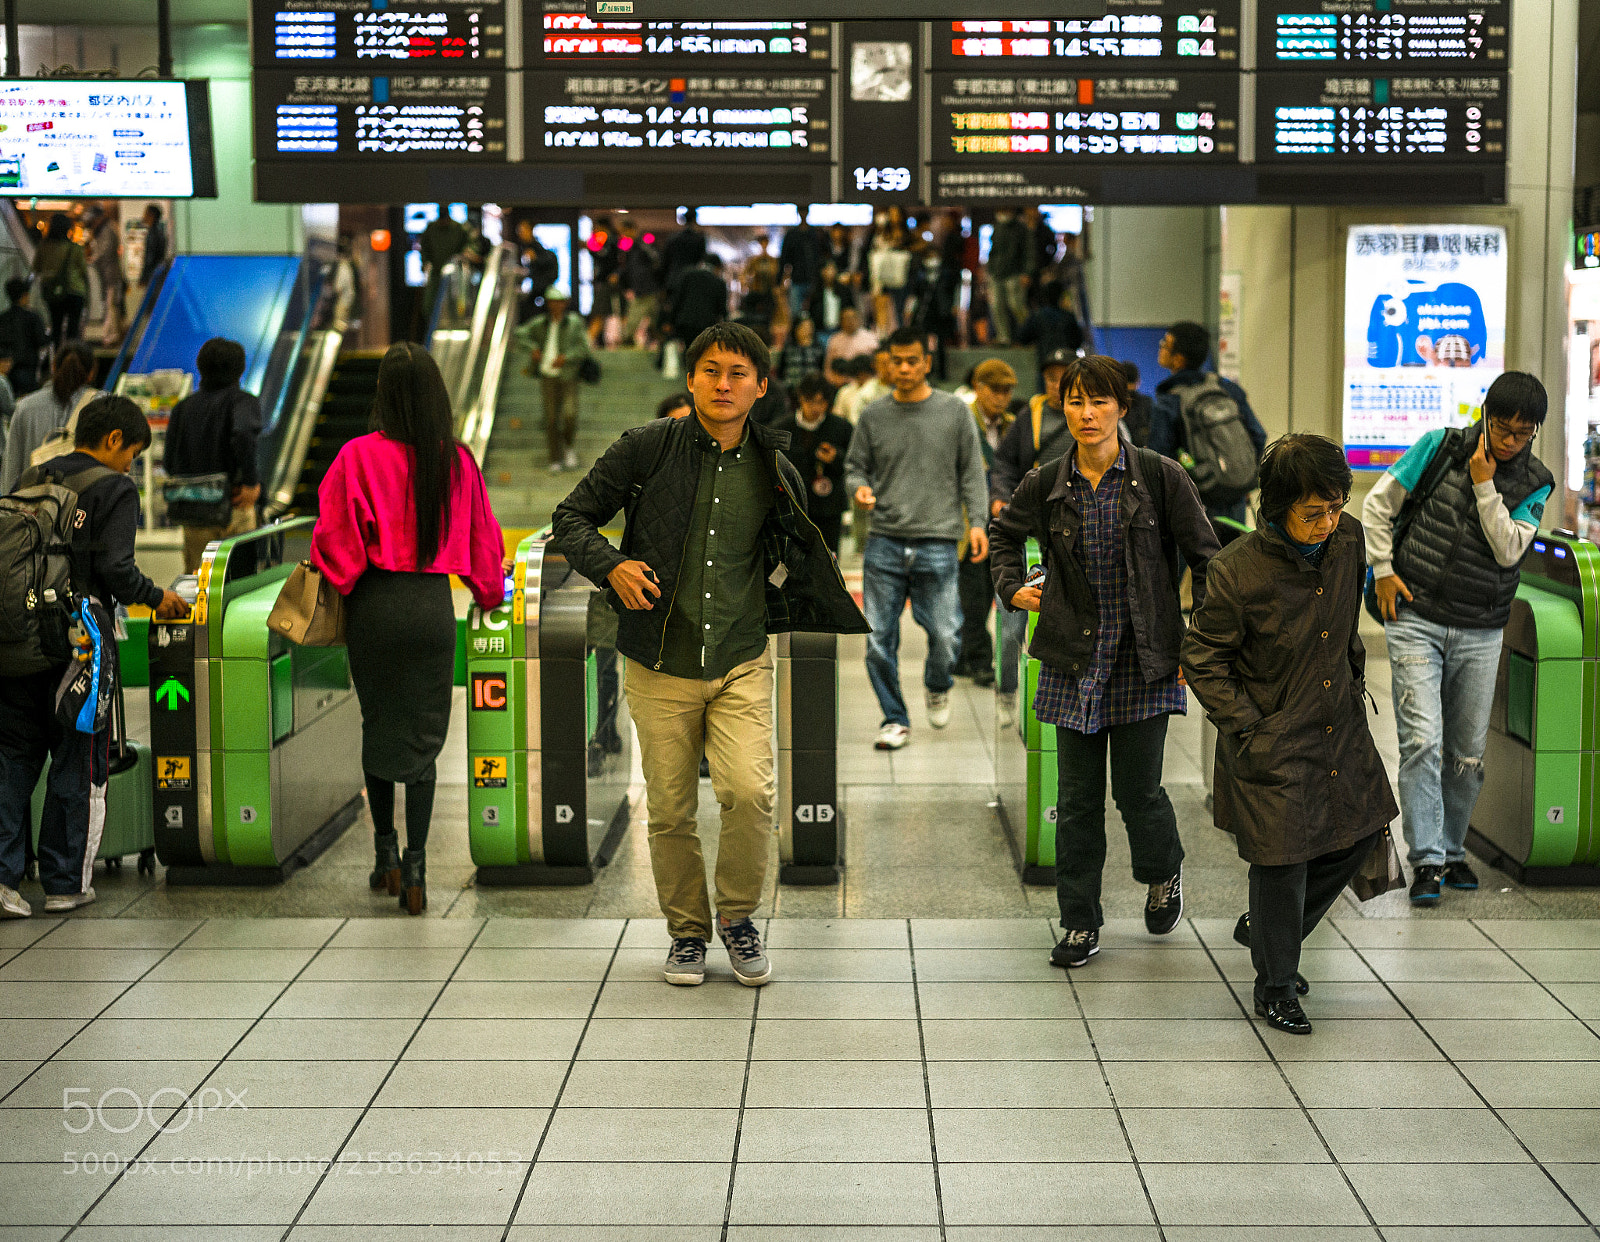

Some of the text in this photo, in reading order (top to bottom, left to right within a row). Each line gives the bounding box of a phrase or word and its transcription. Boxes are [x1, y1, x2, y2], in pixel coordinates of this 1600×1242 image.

[854, 167, 911, 191] 14:39
[1357, 234, 1500, 256] 赤羽耳鼻咽喉科
[472, 605, 511, 631] IC
[472, 637, 505, 654] 専用
[474, 679, 506, 708] IC
[171, 809, 180, 820] 2
[243, 808, 252, 820] 3
[487, 808, 496, 820] 3
[559, 808, 568, 820] 4
[801, 808, 829, 819] 4 5
[1049, 809, 1058, 820] 5
[1552, 809, 1561, 821] 7
